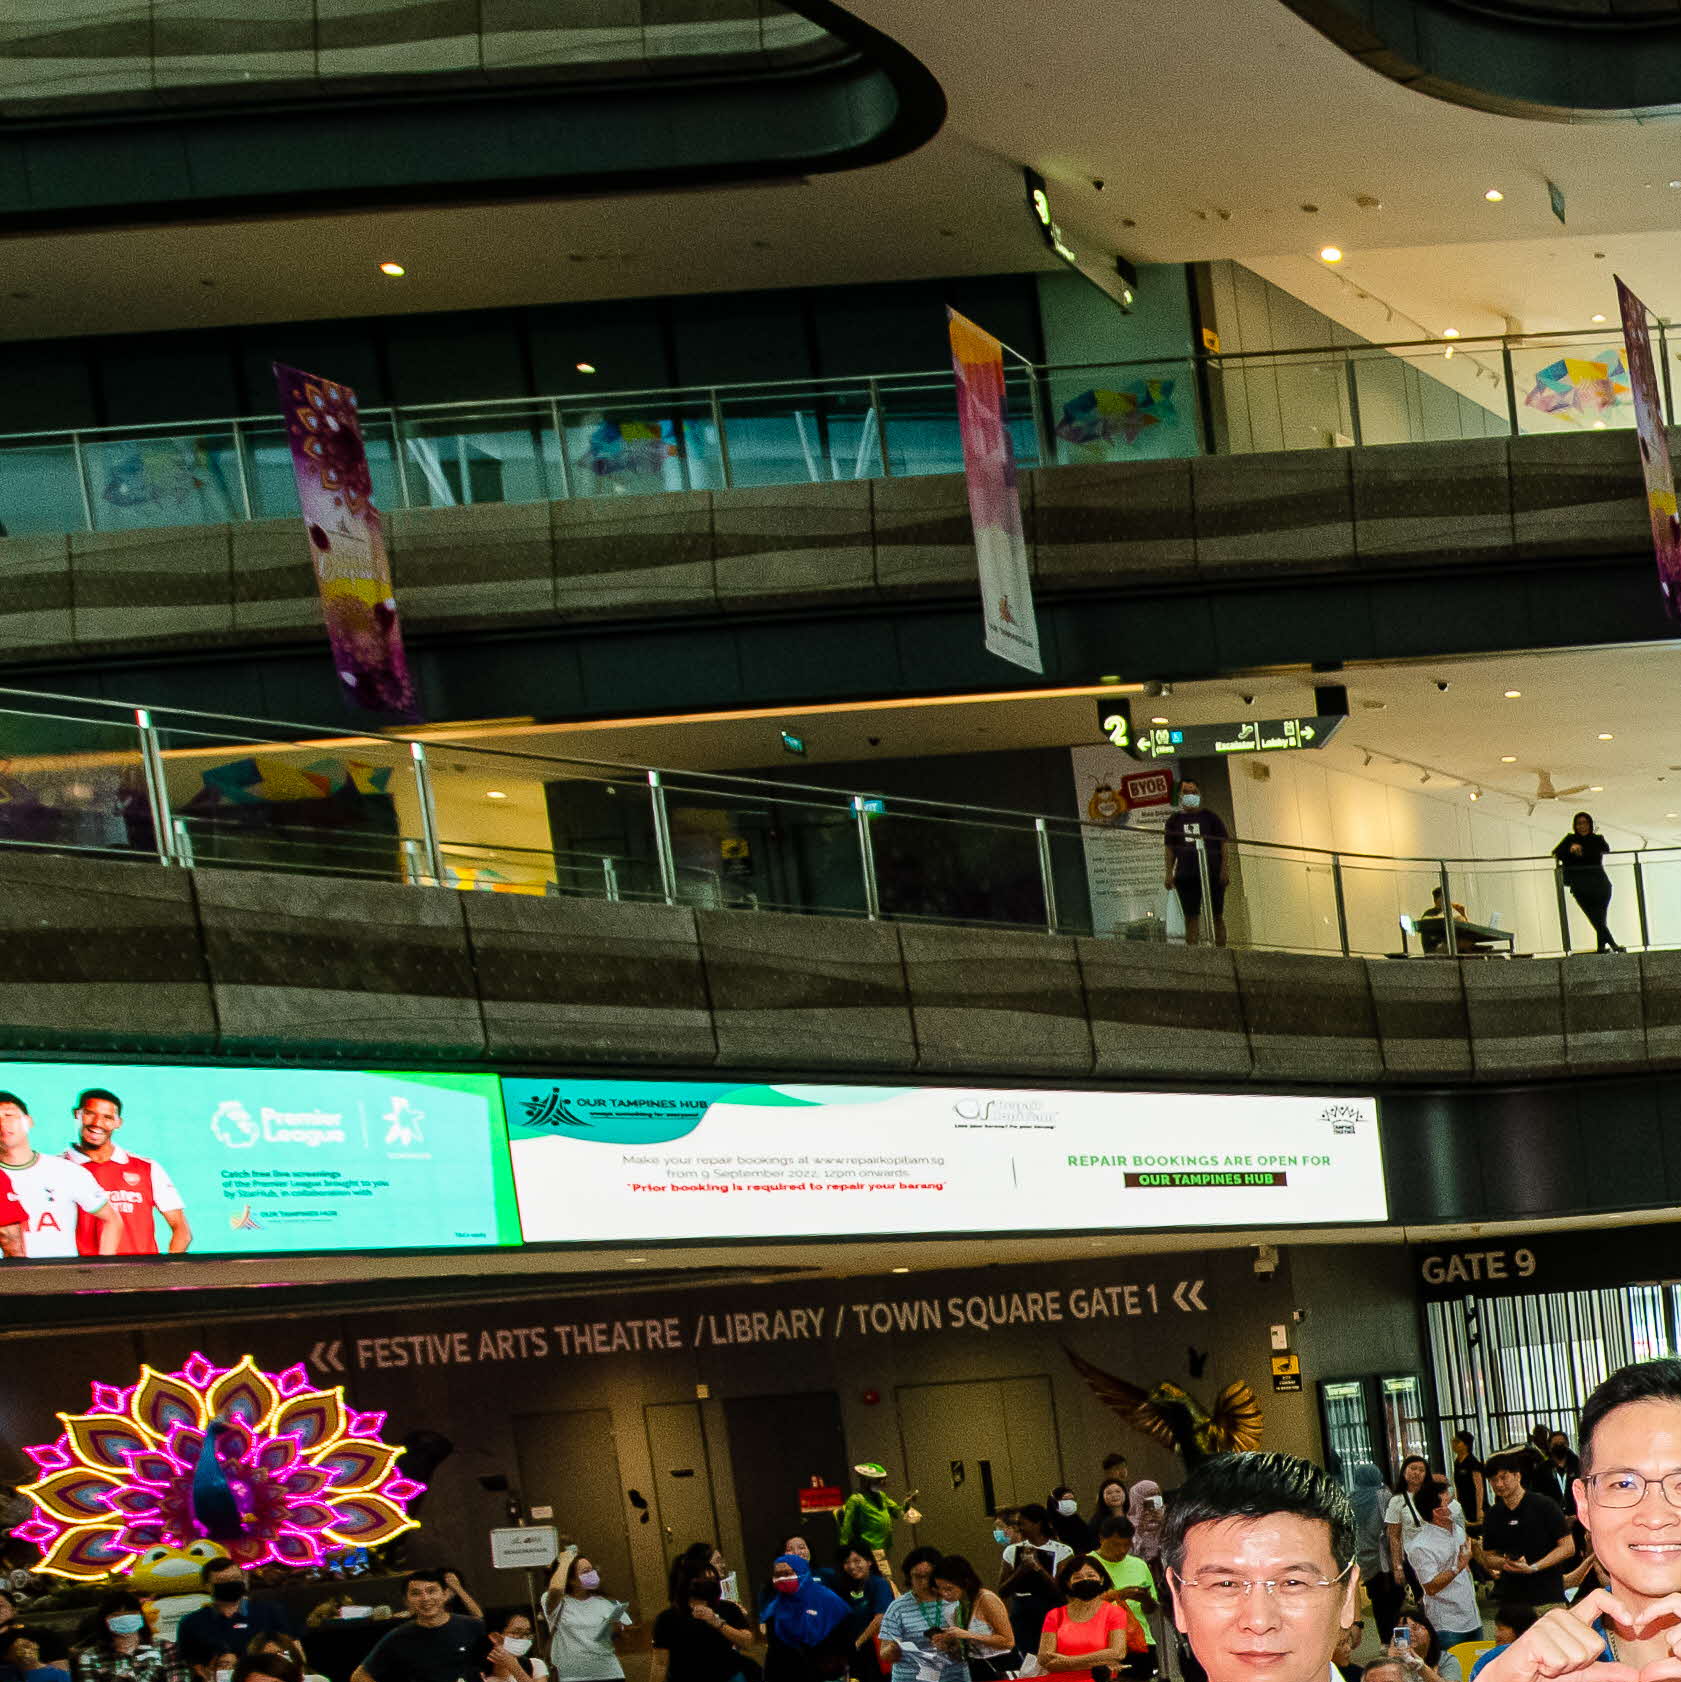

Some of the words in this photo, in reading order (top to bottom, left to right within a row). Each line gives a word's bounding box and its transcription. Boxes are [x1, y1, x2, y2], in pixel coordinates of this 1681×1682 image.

[1104, 715, 1129, 747] 2
[1128, 776, 1168, 797] BYOB
[577, 1098, 607, 1108] OUR
[611, 1098, 677, 1109] TAMPINES
[680, 1099, 709, 1109] HUB
[261, 1107, 342, 1126] Premier
[262, 1129, 345, 1148] League
[623, 1155, 660, 1165] Make
[664, 1156, 692, 1167] your
[696, 1155, 732, 1167] repair
[737, 1156, 794, 1166] bookings
[798, 1156, 809, 1165] at
[1068, 1155, 1127, 1167] REPAIR
[1133, 1155, 1219, 1167] BOOKINGS
[1224, 1155, 1252, 1166] ARE
[1257, 1155, 1297, 1166] OPEN
[1302, 1154, 1331, 1166] FOR
[221, 1169, 250, 1179] Catch
[667, 1169, 698, 1178] from
[713, 1168, 784, 1179] September
[824, 1169, 857, 1178] 12pm
[1139, 1173, 1170, 1186] OUR
[1172, 1173, 1242, 1186] TAMPINES
[1245, 1172, 1274, 1185] HUB
[252, 1180, 287, 1188] Premier
[290, 1180, 321, 1189] League
[671, 1183, 728, 1194] booking
[733, 1183, 742, 1192] is
[747, 1183, 805, 1193] required
[810, 1182, 822, 1192] to
[827, 1182, 865, 1193] repair
[868, 1182, 896, 1192] your
[1421, 1252, 1506, 1286] GATE
[1512, 1249, 1537, 1278] 9
[357, 1331, 472, 1370] FESTIVE
[477, 1325, 549, 1360] ARTS
[554, 1317, 681, 1355] THEATRE
[709, 1307, 826, 1344] LIBRARY
[852, 1298, 944, 1335] TOWN
[947, 1290, 1064, 1328] SQUARE
[1067, 1286, 1142, 1322] GATE
[1146, 1283, 1158, 1314] 1
